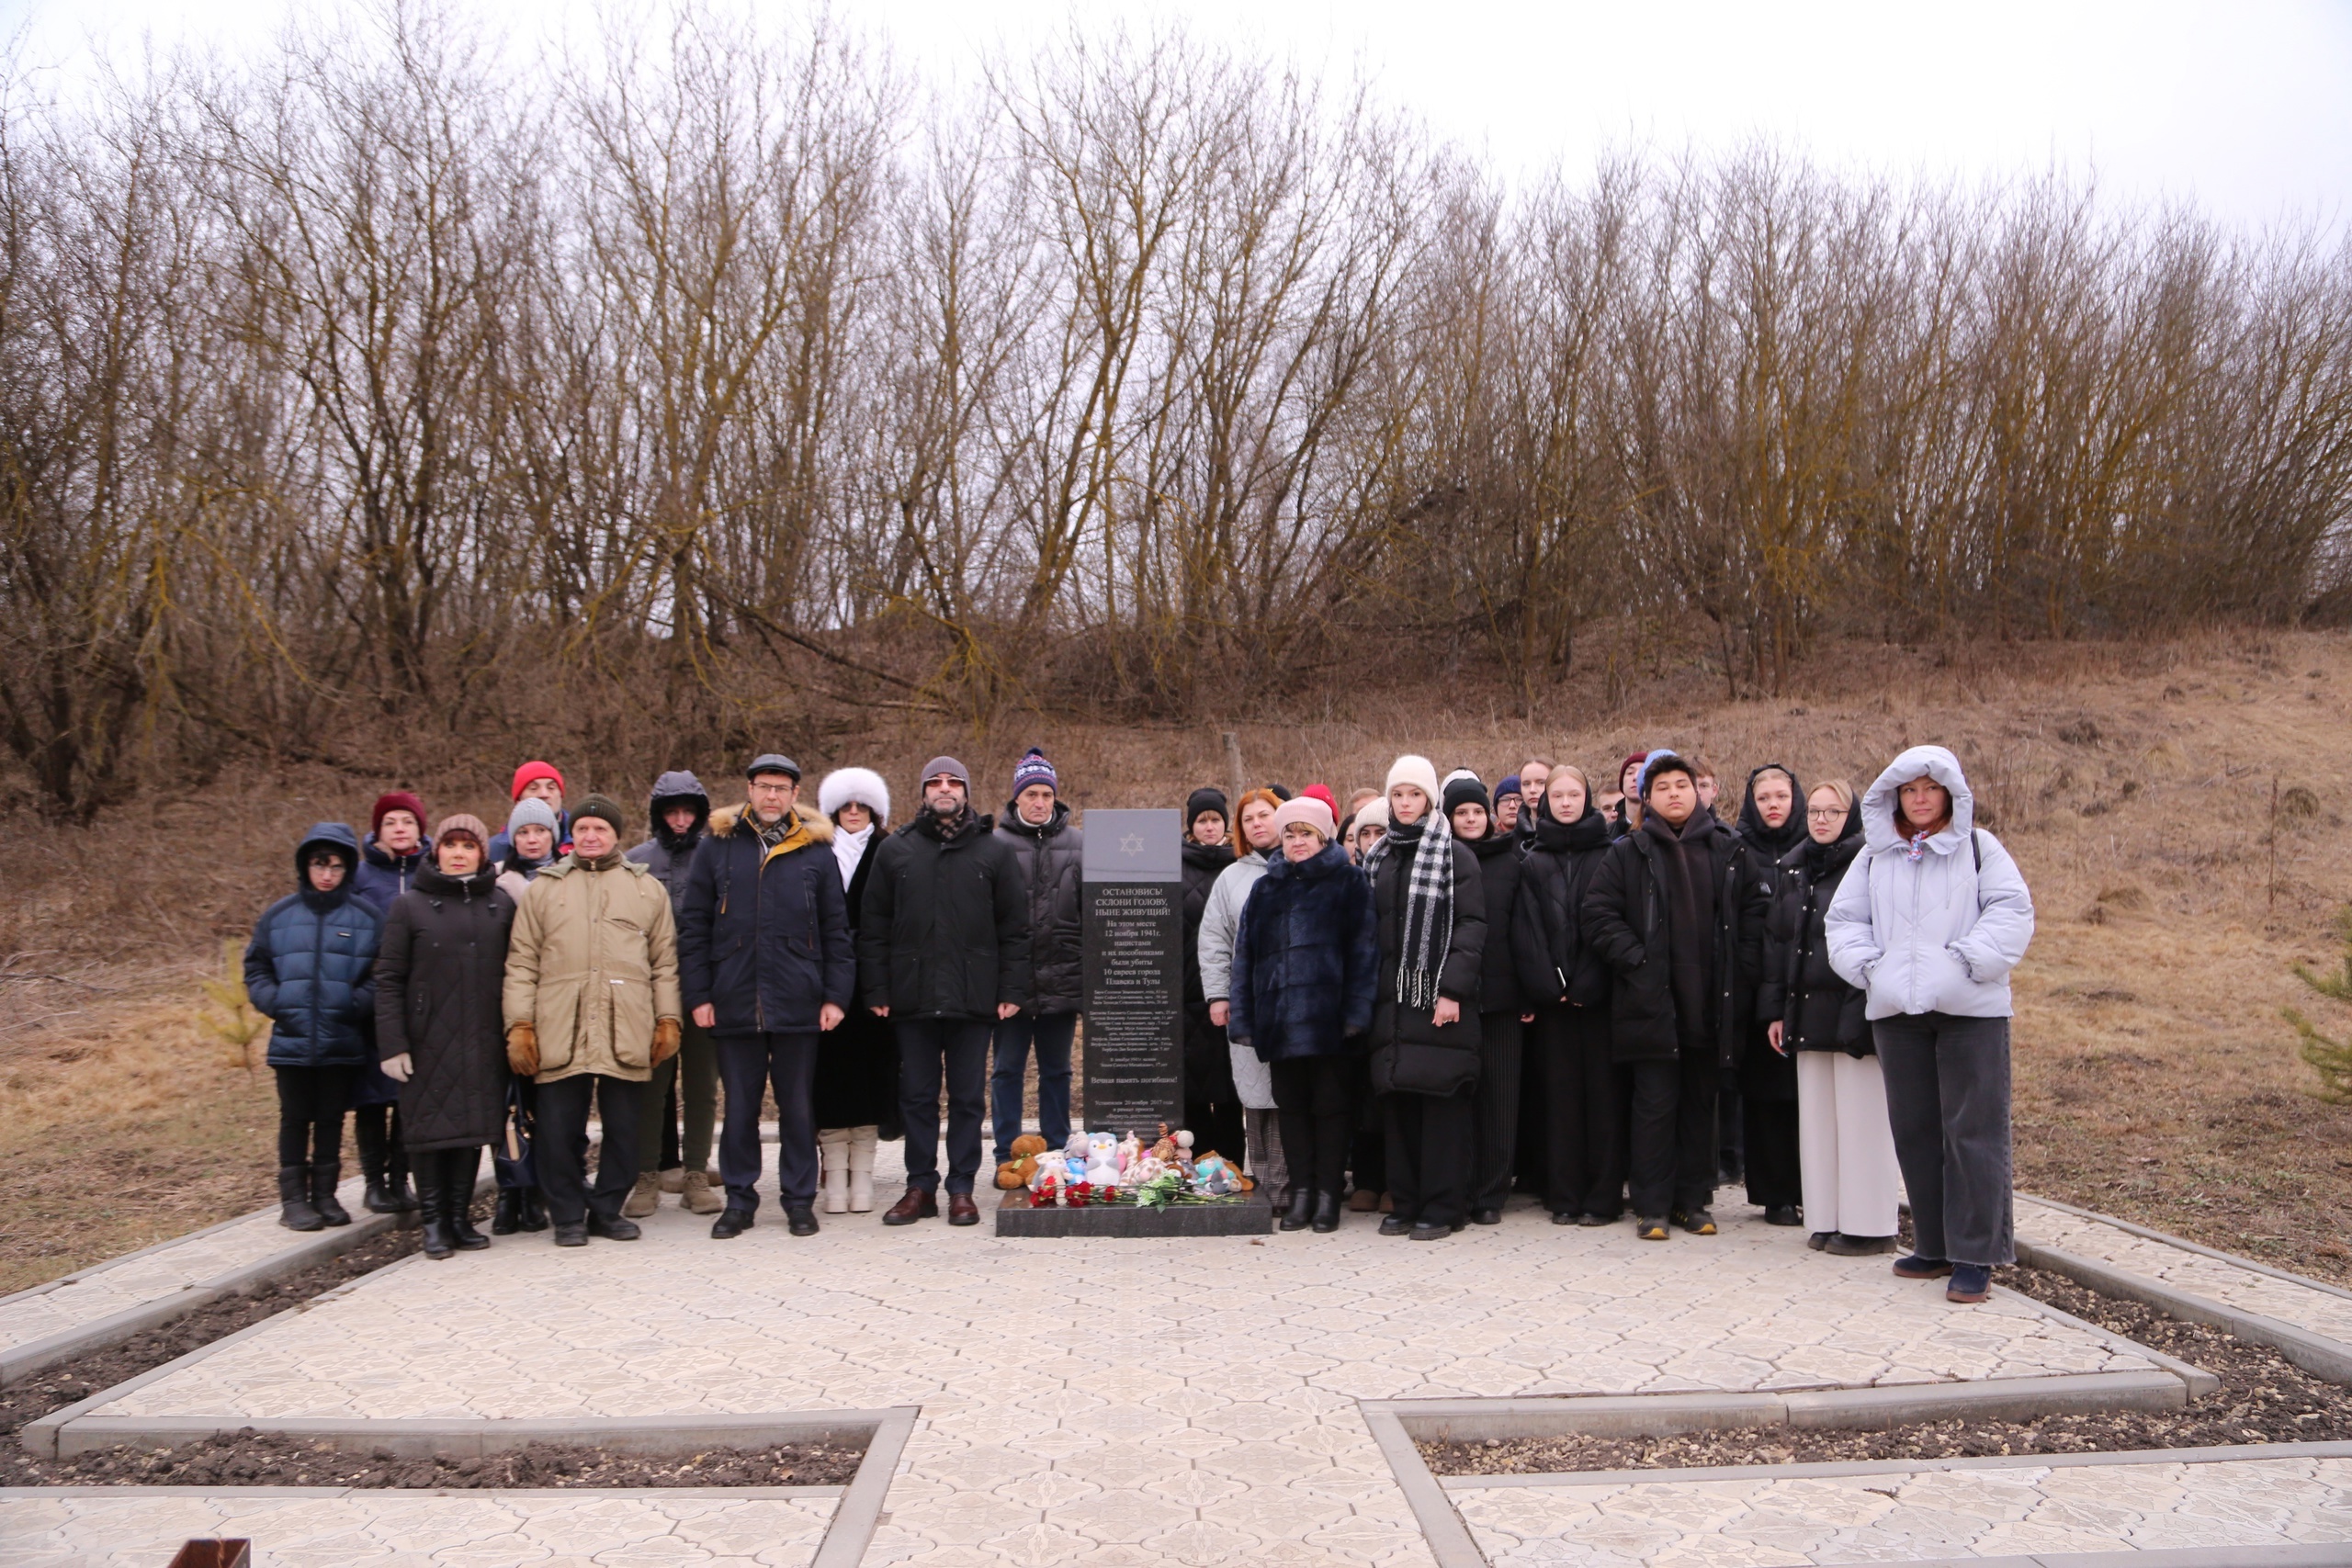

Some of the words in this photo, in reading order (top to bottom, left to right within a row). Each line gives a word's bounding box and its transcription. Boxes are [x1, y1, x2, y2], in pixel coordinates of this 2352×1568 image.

[1134, 898, 1168, 907] ГОЛОВУ,
[1123, 908, 1170, 916] ЖИВУЩИЙ!
[1130, 959, 1152, 967] убиты
